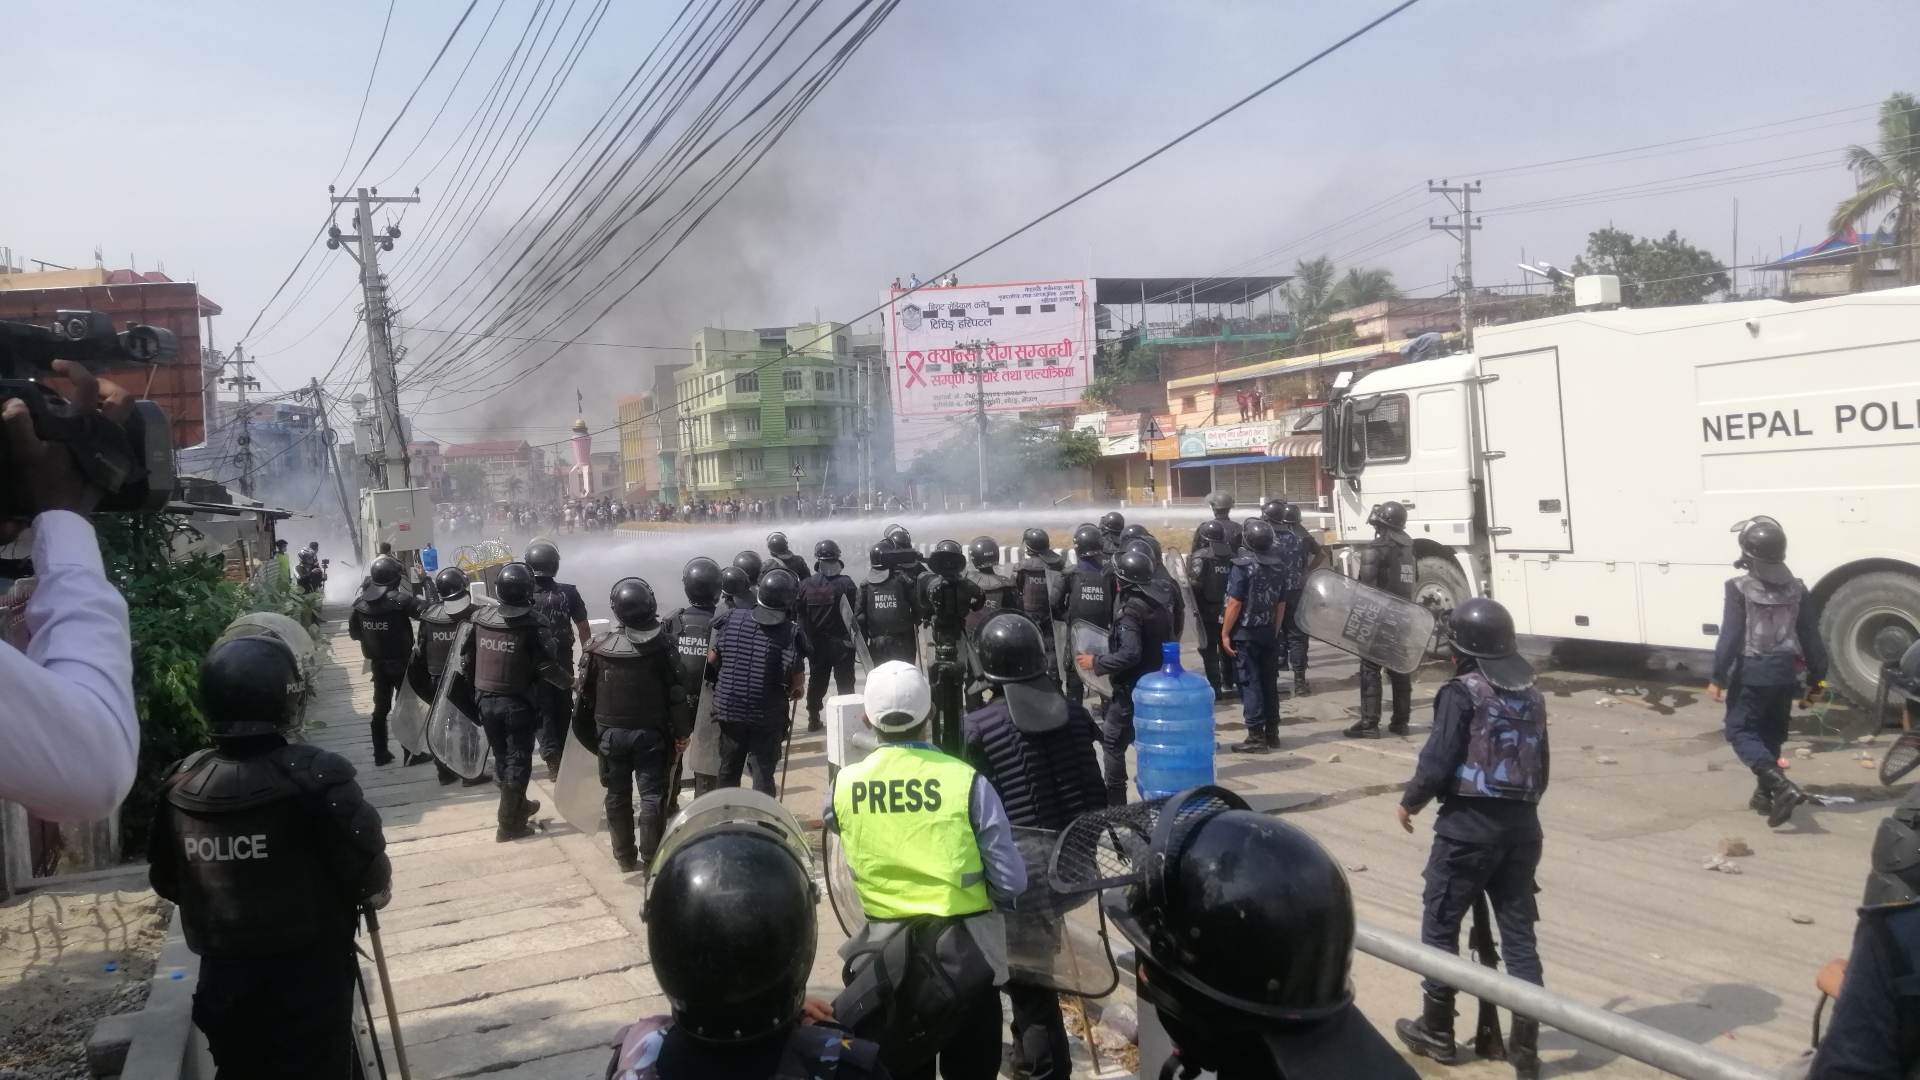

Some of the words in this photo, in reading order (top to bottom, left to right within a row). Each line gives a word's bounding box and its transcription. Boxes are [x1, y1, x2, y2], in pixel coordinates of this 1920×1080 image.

[1001, 370, 1021, 382] तथा
[1702, 409, 1813, 442] NEPAL
[1082, 586, 1104, 594] NEPAL
[874, 594, 897, 602] NEPAL
[1081, 593, 1104, 601] POLICE
[874, 601, 897, 609] POLICE
[1345, 603, 1368, 637] NEPAL
[362, 621, 389, 631] POLICE
[479, 638, 515, 653] POLICE
[678, 636, 708, 646] NEPAL
[678, 646, 708, 656] POLICE
[852, 778, 942, 814] PRESS
[184, 834, 268, 861] POLICE
